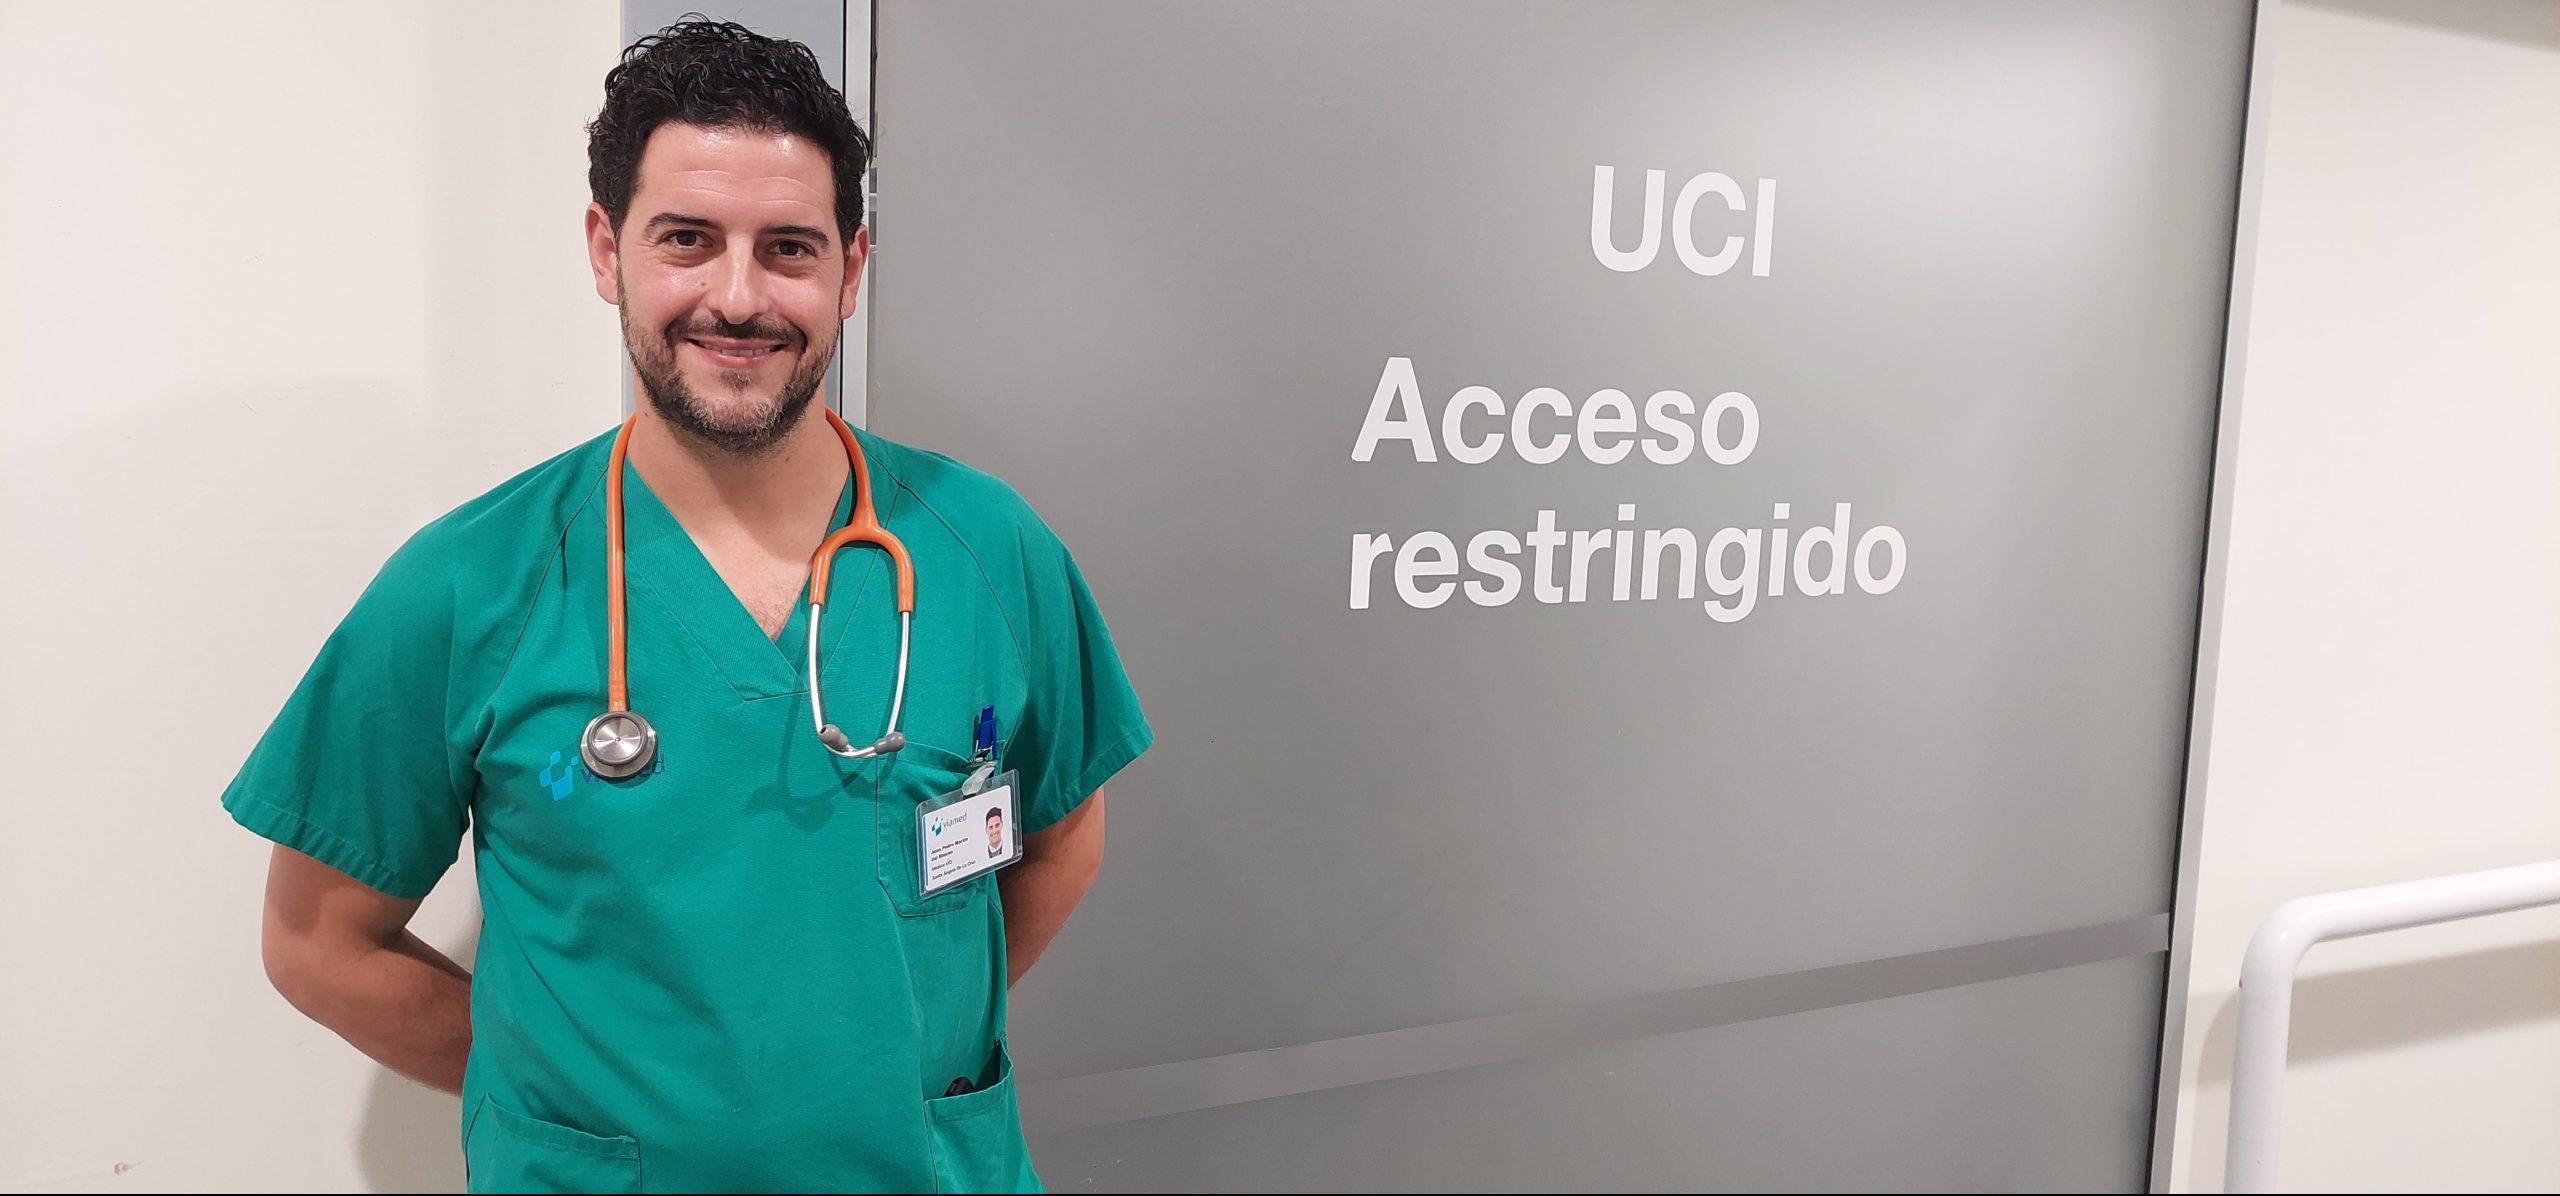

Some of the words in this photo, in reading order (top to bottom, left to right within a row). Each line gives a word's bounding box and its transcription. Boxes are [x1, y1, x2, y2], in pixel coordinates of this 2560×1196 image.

[1591, 165, 1776, 276] UCI
[1351, 357, 1760, 464] Acceso
[1349, 503, 1907, 622] restringido
[943, 811, 967, 828] viamed
